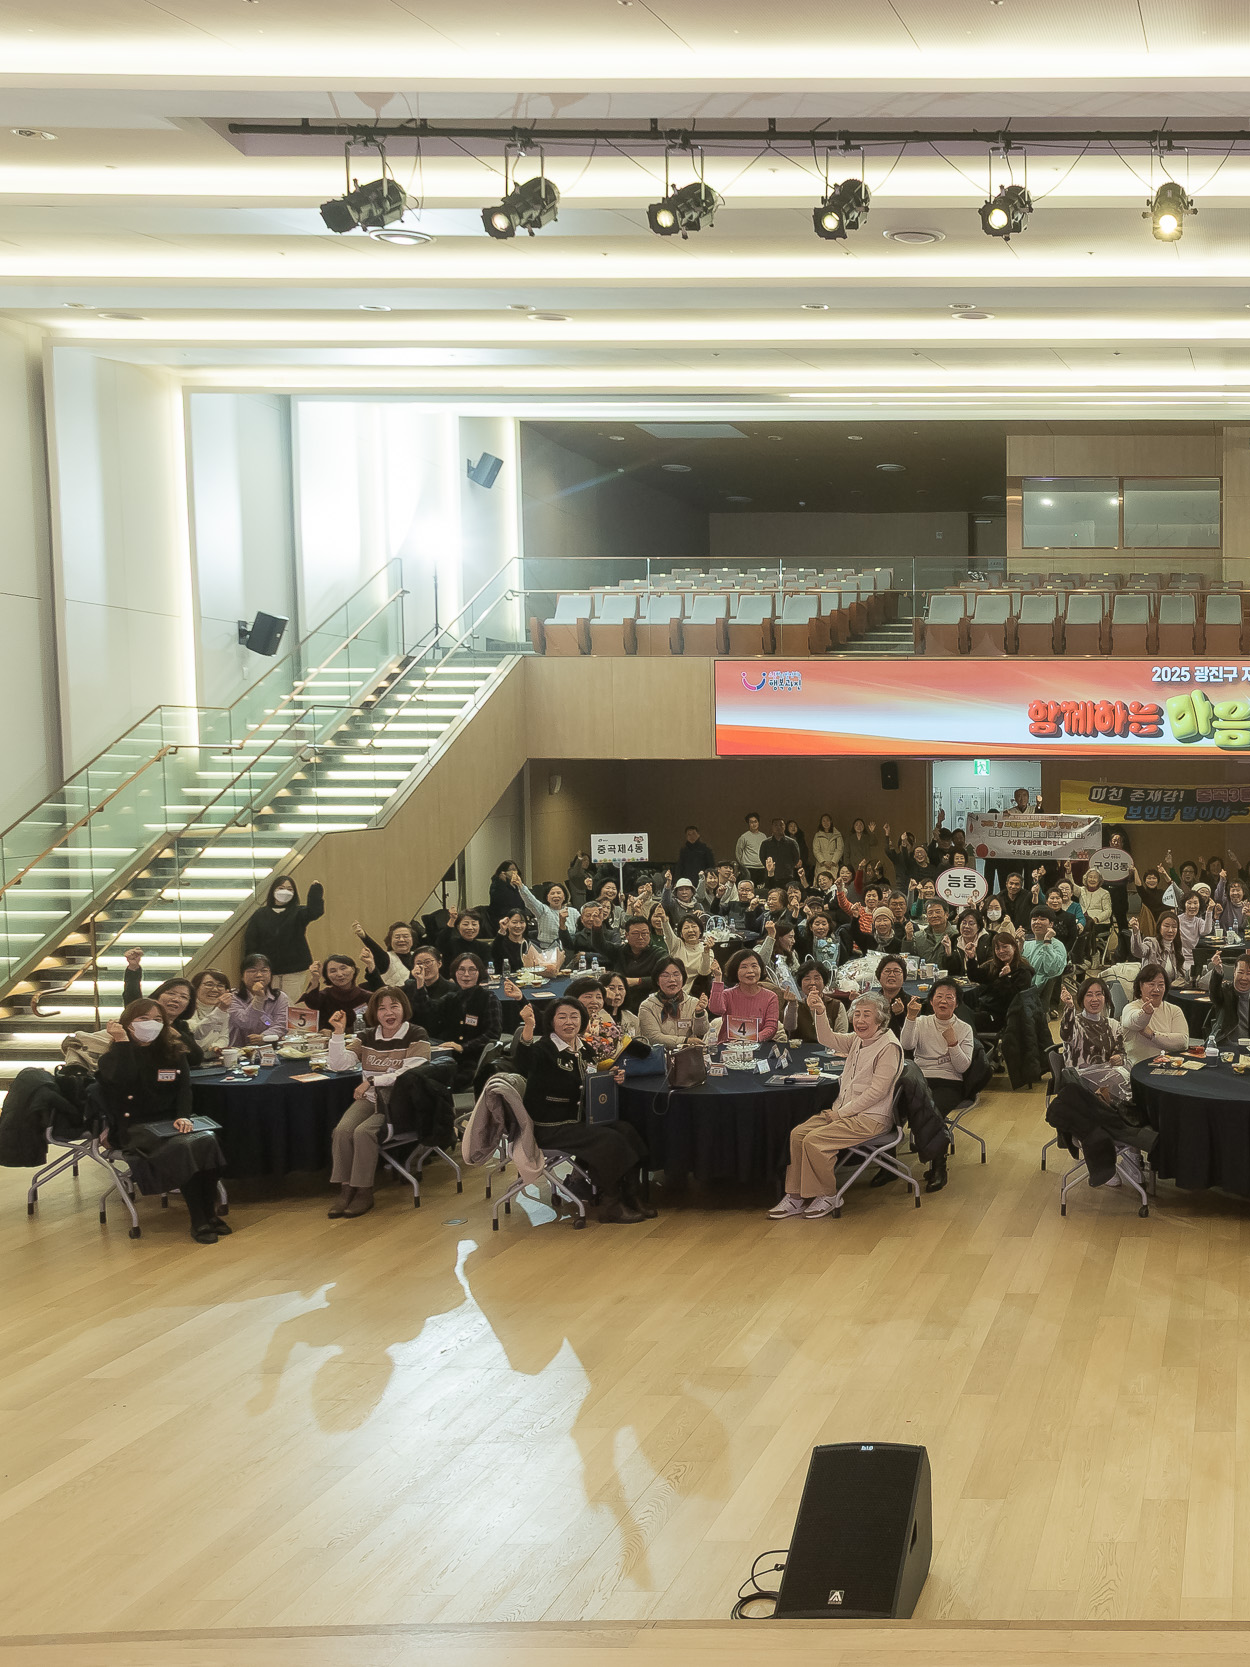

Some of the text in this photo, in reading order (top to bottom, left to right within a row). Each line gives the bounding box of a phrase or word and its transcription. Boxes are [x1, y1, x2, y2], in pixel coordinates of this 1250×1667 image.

[1151, 666, 1191, 682] 2025
[1194, 666, 1238, 683] 광진구
[1028, 700, 1162, 736] 함께하는
[1090, 787, 1123, 801] 미친
[1130, 788, 1185, 803] 존재감!
[1127, 805, 1176, 820] 보인단
[597, 843, 643, 855] 중곡제4동
[1094, 861, 1129, 871] 구의3동
[948, 874, 976, 889] 능동
[297, 1013, 306, 1027] 5
[737, 1022, 746, 1036] 4
